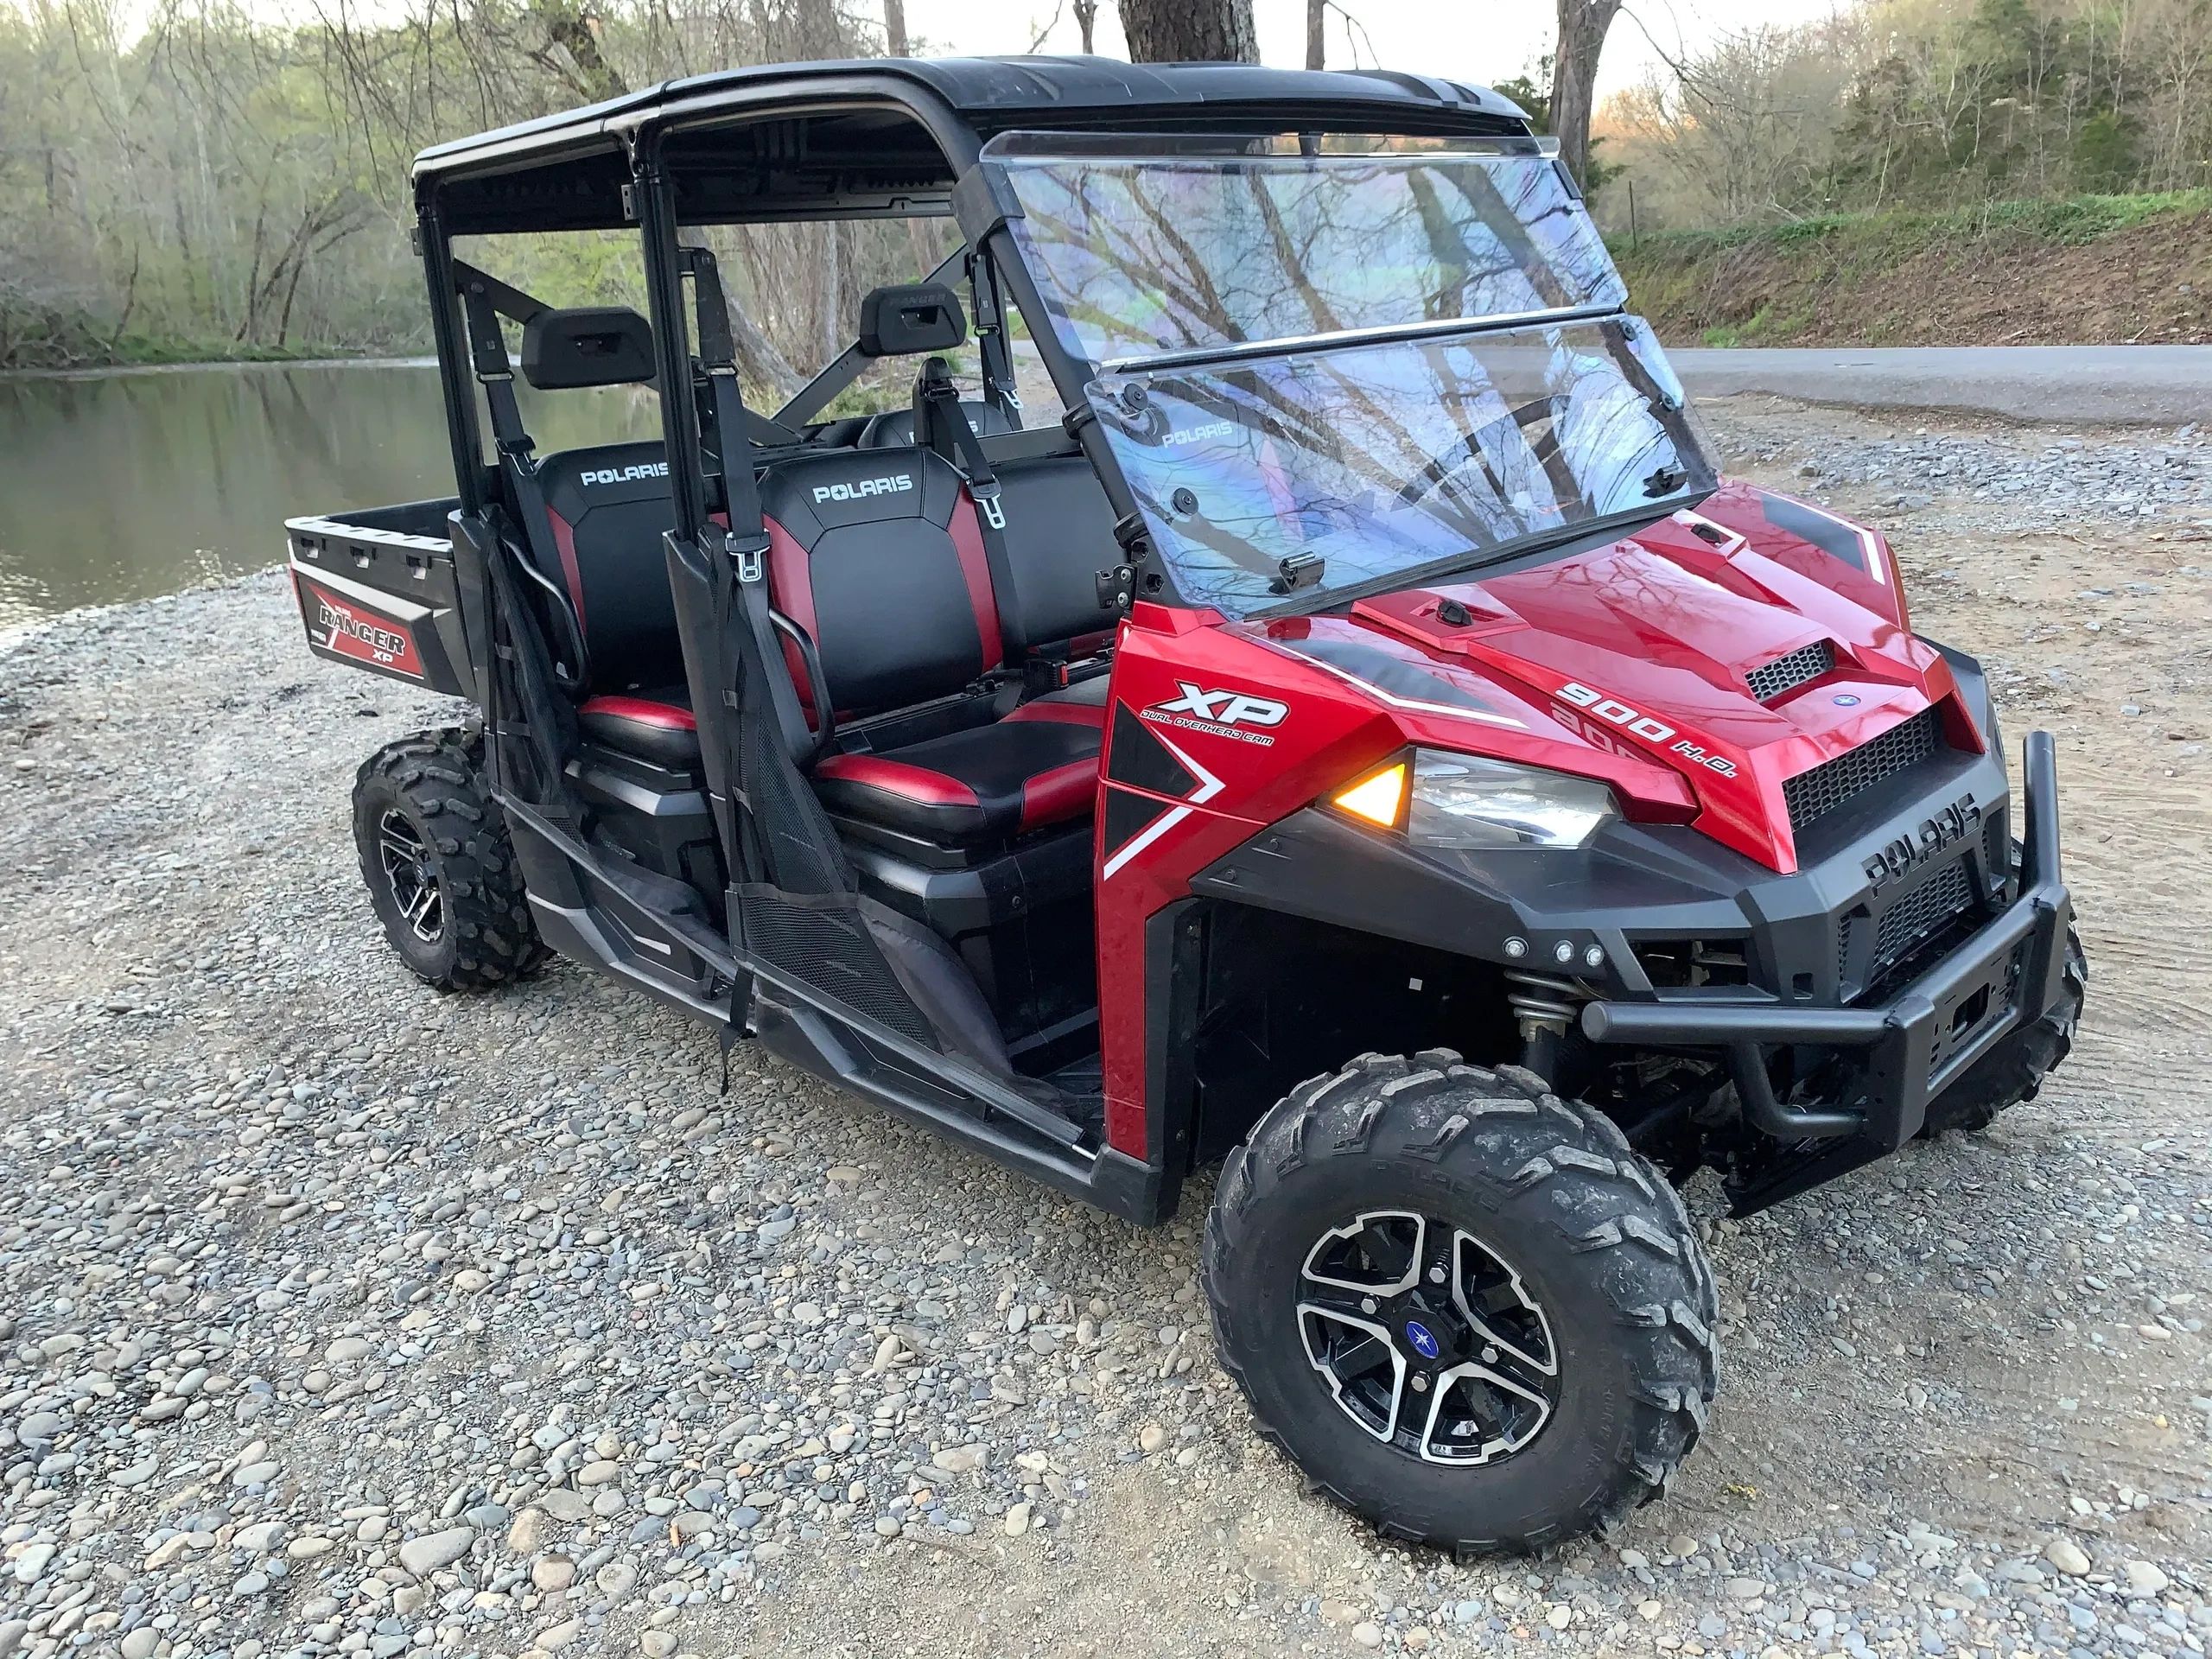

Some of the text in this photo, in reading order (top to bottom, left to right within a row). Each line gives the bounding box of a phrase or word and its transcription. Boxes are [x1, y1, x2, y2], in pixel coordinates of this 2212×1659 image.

[1161, 421, 1233, 448] POLARIS
[581, 461, 670, 486] POLARIS
[812, 474, 913, 504] POLARIS
[319, 605, 406, 657] RANGER
[372, 648, 394, 664] XP
[1146, 679, 1290, 728] XP
[1554, 681, 1678, 744] 900
[1140, 709, 1275, 747] DUAL OVERHEAD CAM
[1861, 792, 1981, 900] POLARIS
